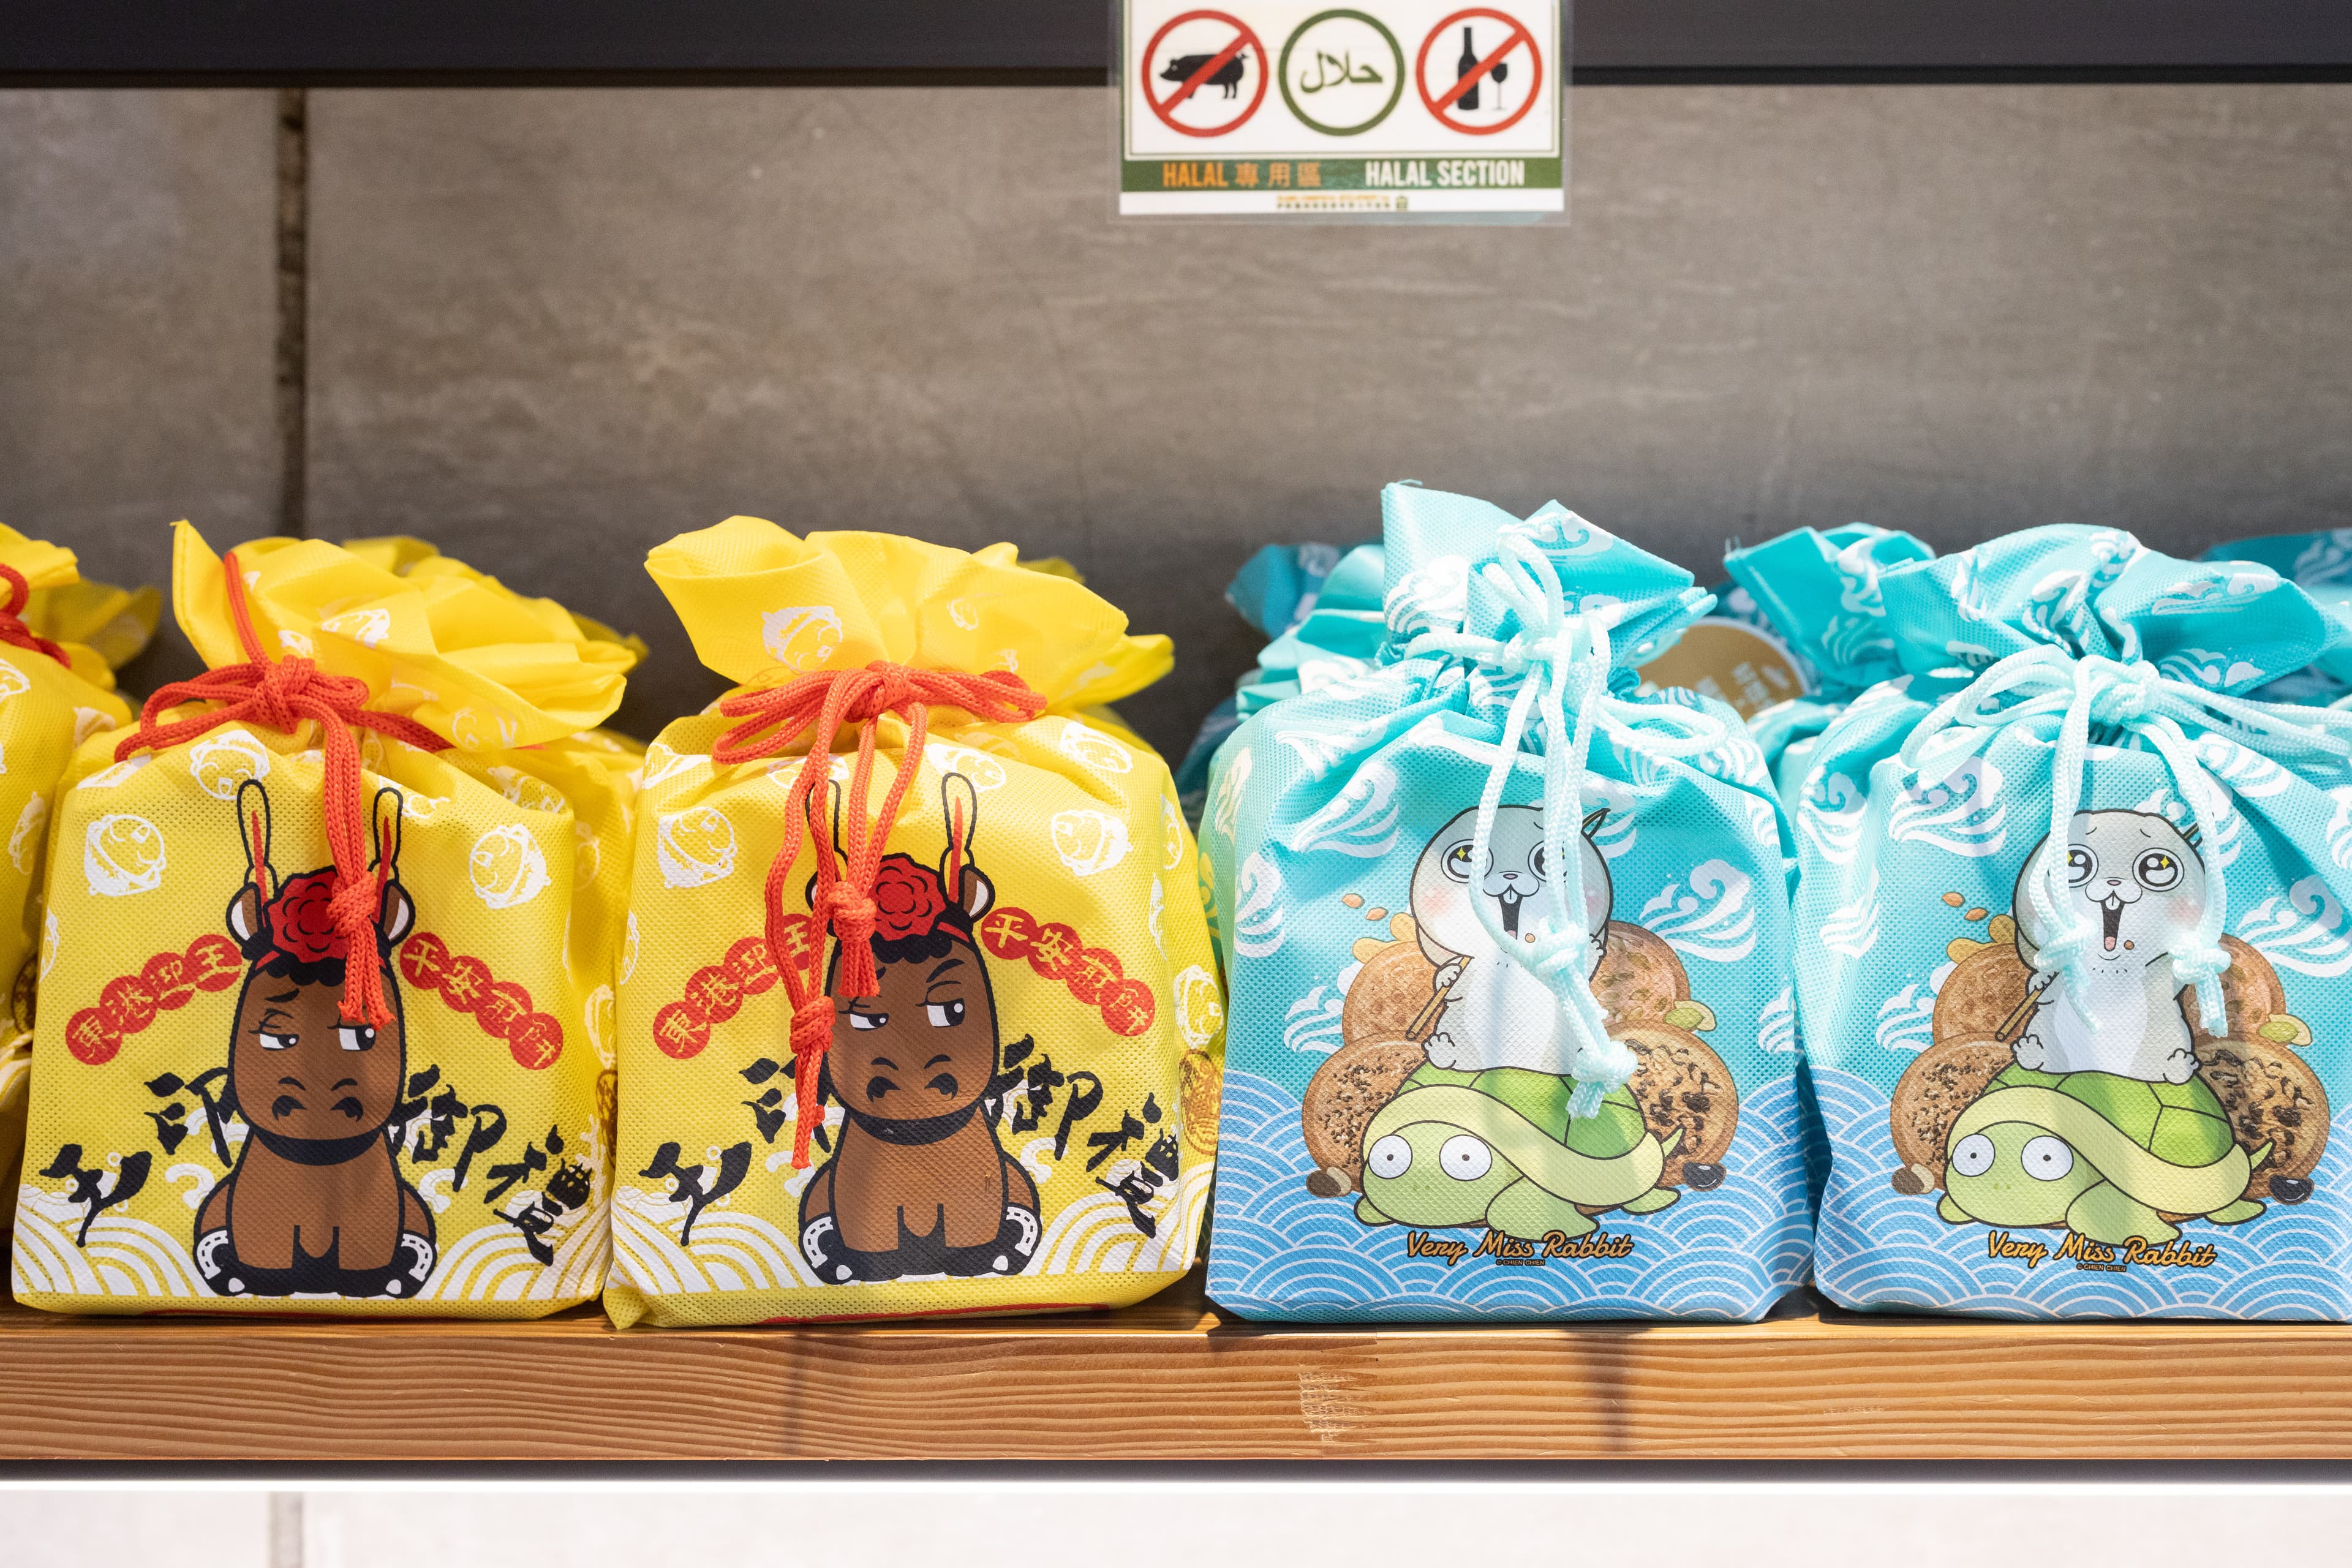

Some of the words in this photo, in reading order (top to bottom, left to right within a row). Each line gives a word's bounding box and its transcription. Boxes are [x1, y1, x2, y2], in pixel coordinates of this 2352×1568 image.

[1301, 48, 1383, 93] حلال
[1163, 161, 1229, 187] HALAL
[1365, 160, 1433, 187] HALAL
[1436, 159, 1525, 187] SECTION
[1408, 1231, 1468, 1266] Very
[1473, 1229, 1535, 1259] Miss
[1542, 1231, 1635, 1259] Rabbit
[1988, 1230, 2048, 1268] Very
[2053, 1231, 2116, 1263] Miss
[2122, 1234, 2217, 1267] Rabbit
